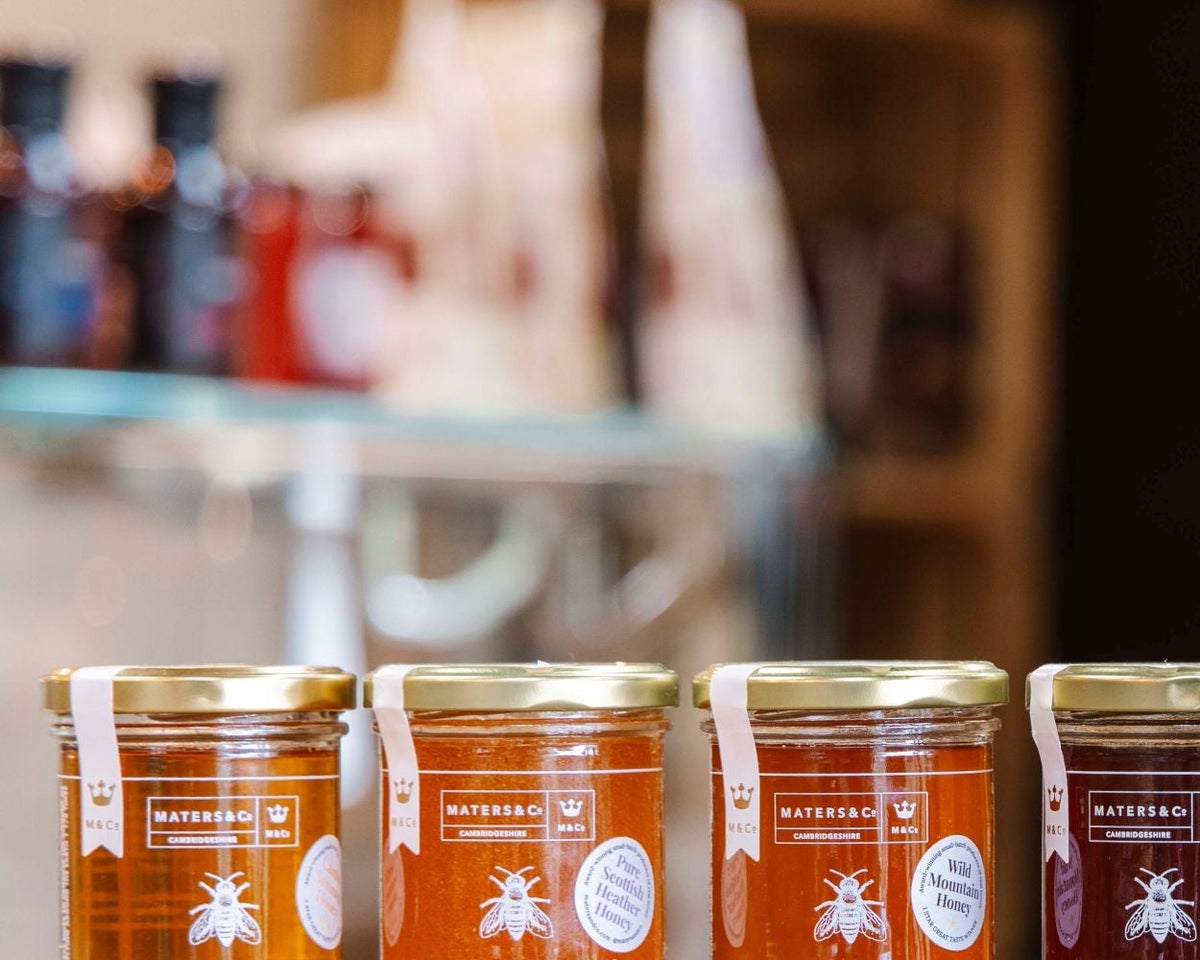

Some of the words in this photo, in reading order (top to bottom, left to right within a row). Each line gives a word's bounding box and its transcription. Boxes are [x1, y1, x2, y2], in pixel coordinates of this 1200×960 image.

[459, 829, 527, 838] CAMBRIDGESHIRE
[793, 832, 861, 840] CAMBRIDGESHIRE
[1105, 830, 1171, 839] CAMBRIDGESHIRE
[616, 854, 641, 880] Pure
[948, 858, 972, 879] Wild
[603, 865, 645, 902] Scottish
[928, 872, 980, 901] Mountain
[595, 882, 641, 918] Heather
[936, 892, 972, 918] Honey
[594, 901, 633, 934] Honey
[933, 925, 950, 941] GREAT
